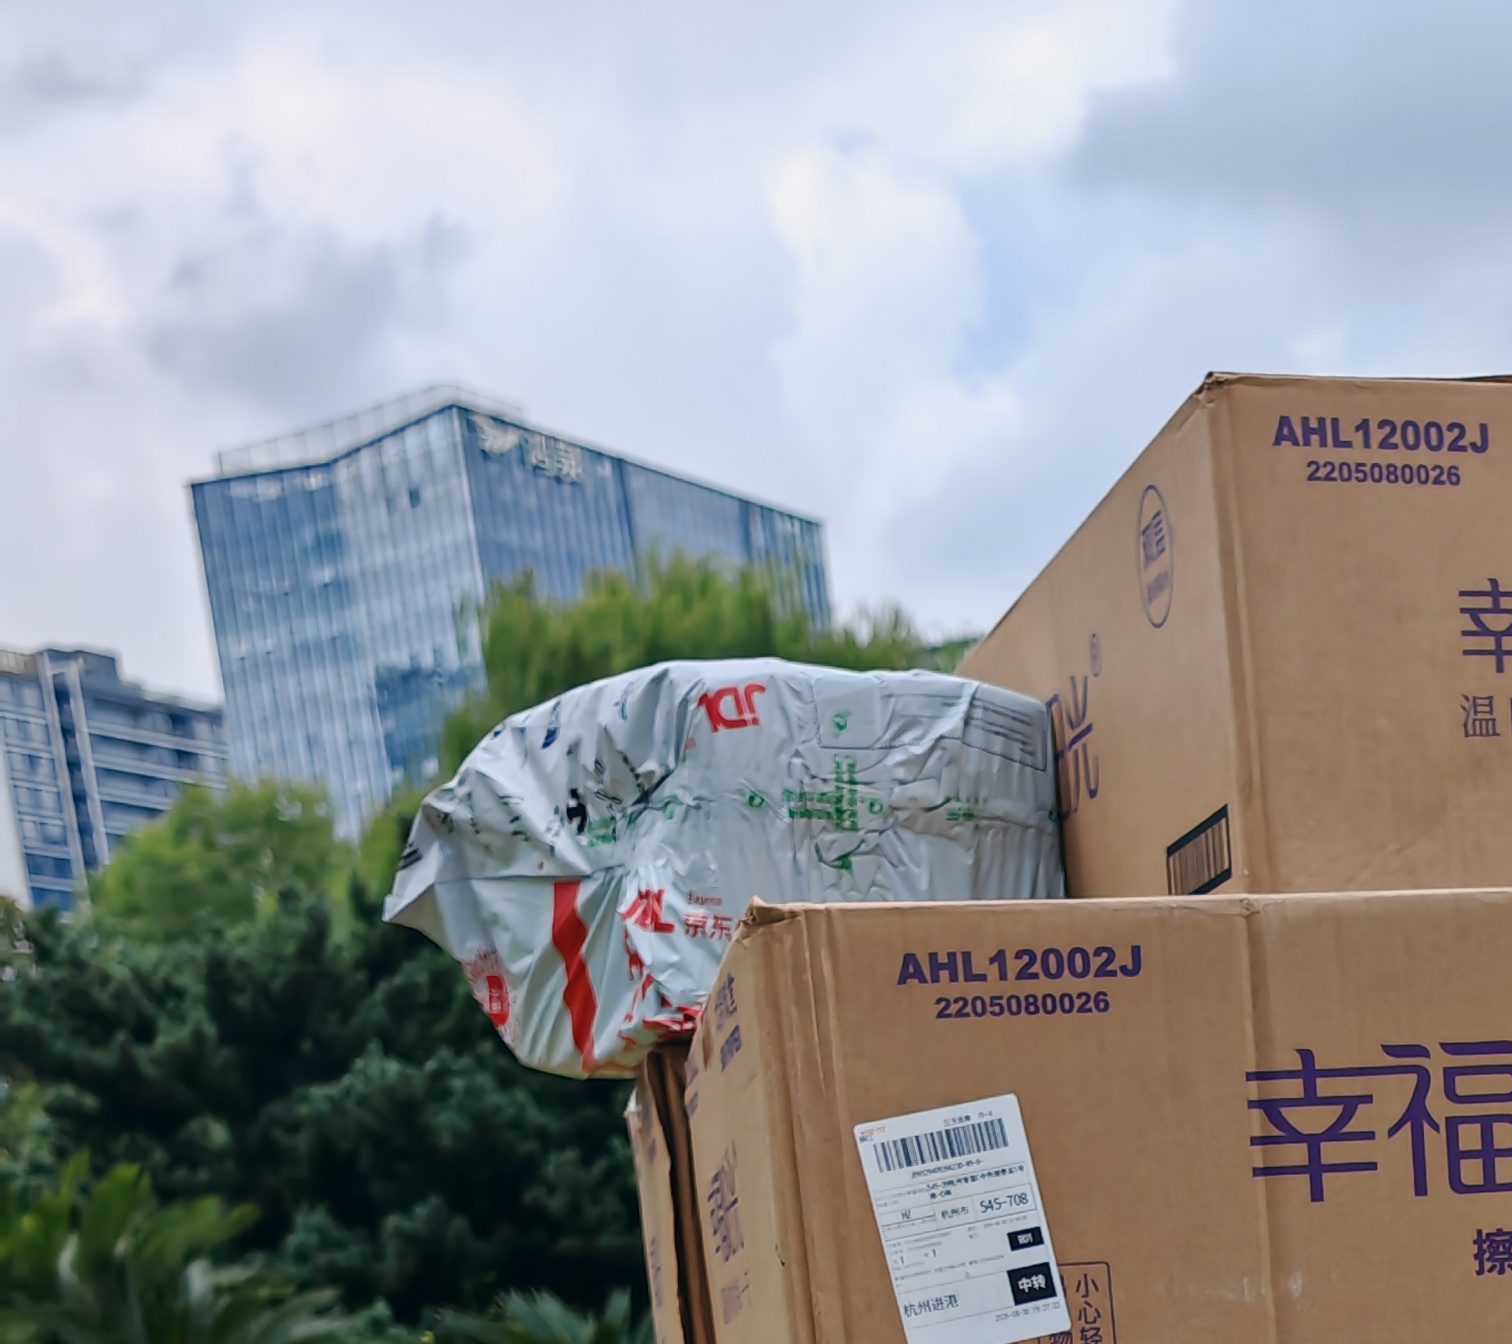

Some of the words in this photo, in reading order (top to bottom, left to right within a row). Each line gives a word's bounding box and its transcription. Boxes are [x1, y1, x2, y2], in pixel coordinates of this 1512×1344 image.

[1272, 416, 1490, 454] AHL12002J
[1306, 459, 1461, 486] 2205080026
[684, 913, 736, 942] 京东
[897, 944, 1144, 985] AHL12002J
[935, 991, 1111, 1020] 2205080026
[978, 1191, 1029, 1214] 545-708
[901, 1293, 959, 1318] 杭州进港
